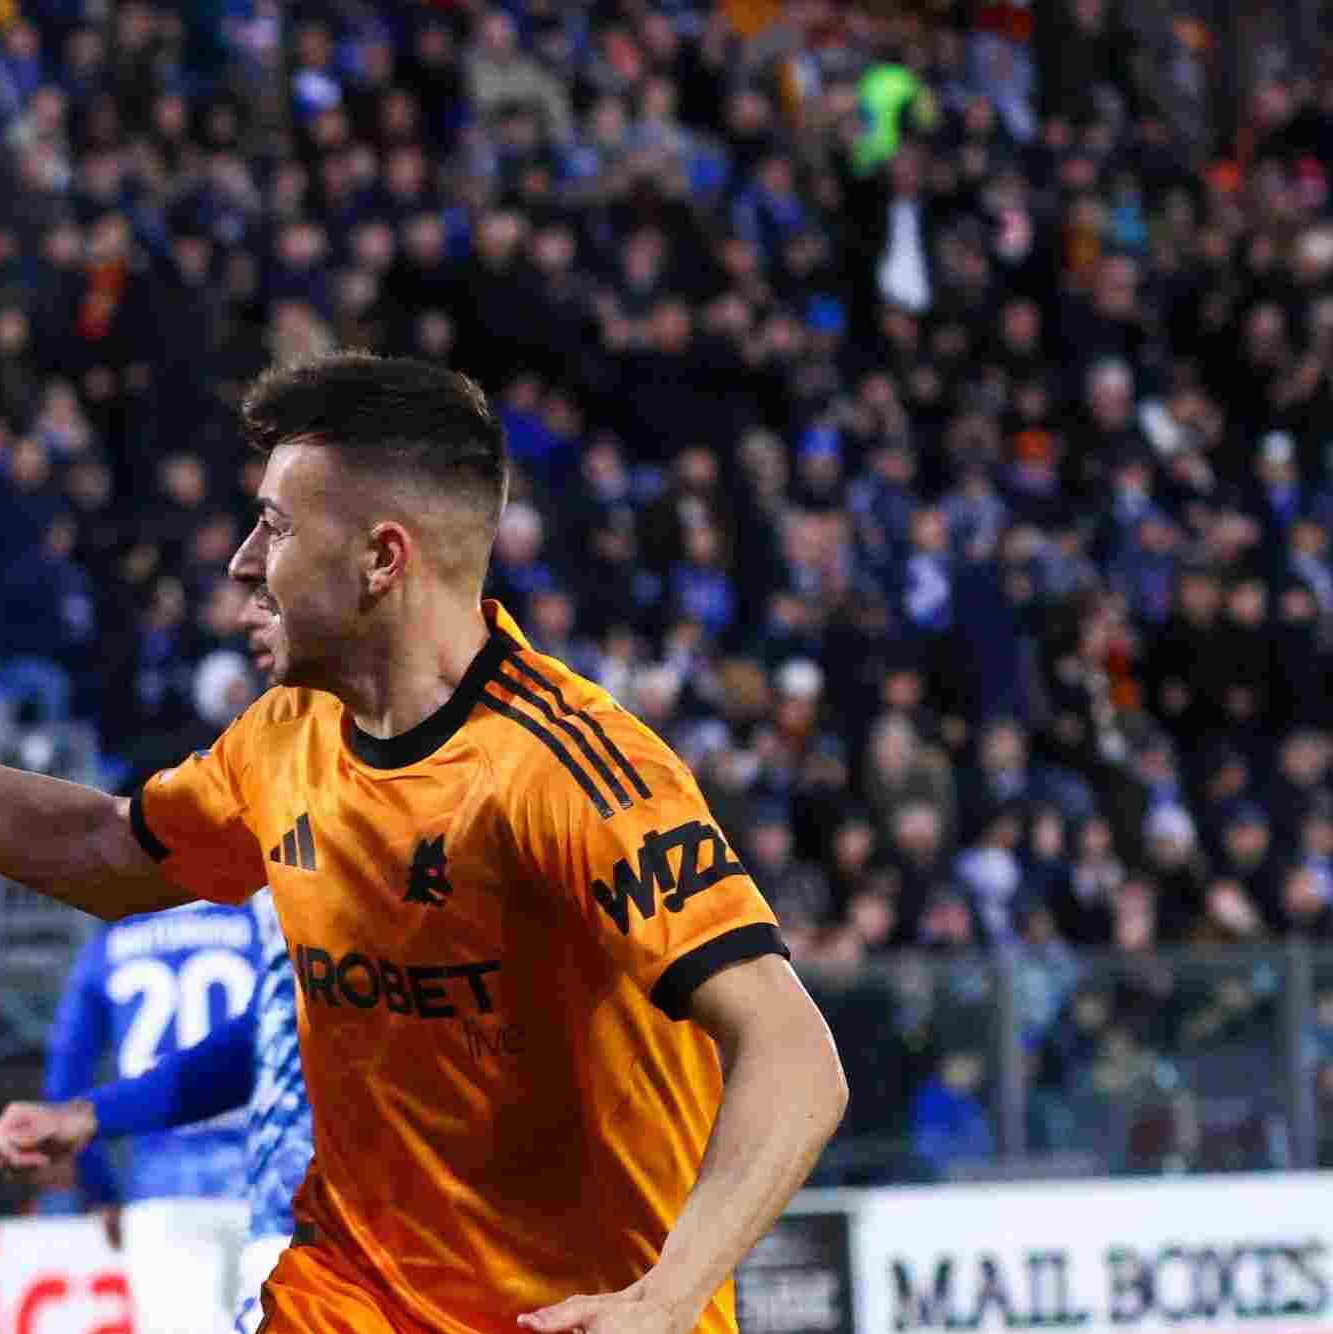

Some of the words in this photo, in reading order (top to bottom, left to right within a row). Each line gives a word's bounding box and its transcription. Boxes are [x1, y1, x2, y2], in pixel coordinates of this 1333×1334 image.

[106, 950, 258, 1080] 20
[296, 943, 501, 1018] ROBET
[891, 1248, 1091, 1333] MAIL
[1107, 1240, 1333, 1325] BOXES
